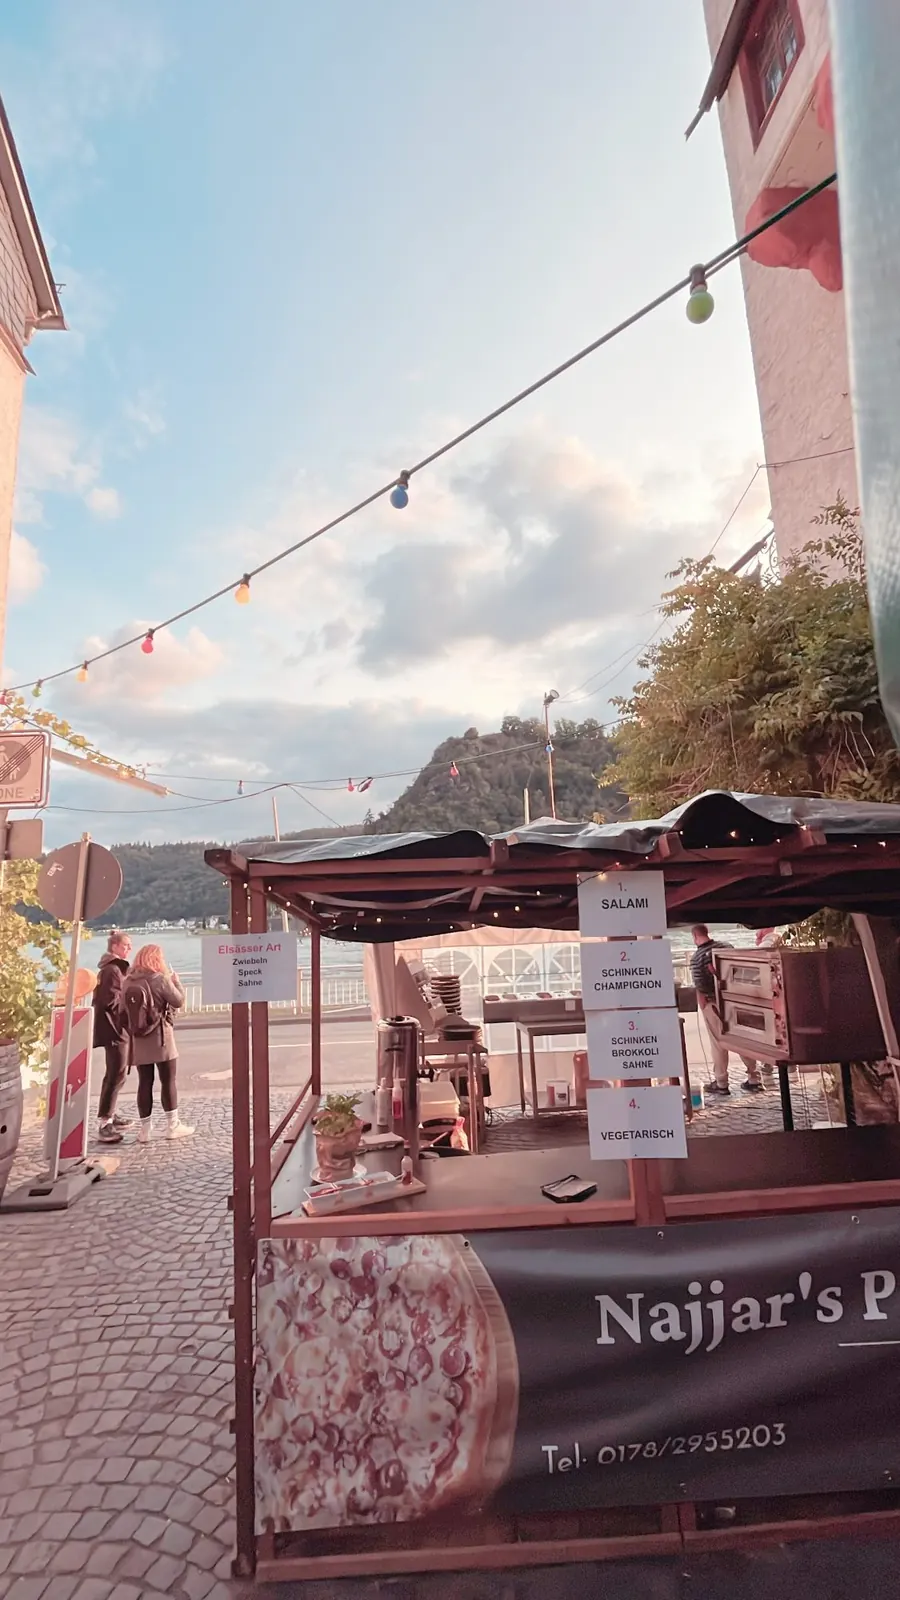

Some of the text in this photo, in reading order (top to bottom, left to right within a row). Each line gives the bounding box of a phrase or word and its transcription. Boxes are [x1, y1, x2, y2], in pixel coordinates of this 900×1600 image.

[618, 882, 627, 892] 1.
[601, 898, 649, 909] SALAMI
[218, 943, 281, 954] Elsässer Art
[232, 957, 268, 966] Zwiebeln
[620, 951, 631, 962] 2.
[238, 969, 263, 977] Speck
[601, 967, 652, 977] SCHINKEN
[594, 980, 662, 991] CHAMPIGNON
[628, 1021, 639, 1031] 3.
[611, 1036, 658, 1045] SCHINKEN
[612, 1048, 659, 1057] BROKKOLI
[622, 1060, 654, 1069] SAHNE
[628, 1098, 640, 1109] 4.
[601, 1129, 674, 1140] VEGETARISCH
[594, 1270, 896, 1355] Najjar's P
[597, 1423, 787, 1465] 0178/2955203
